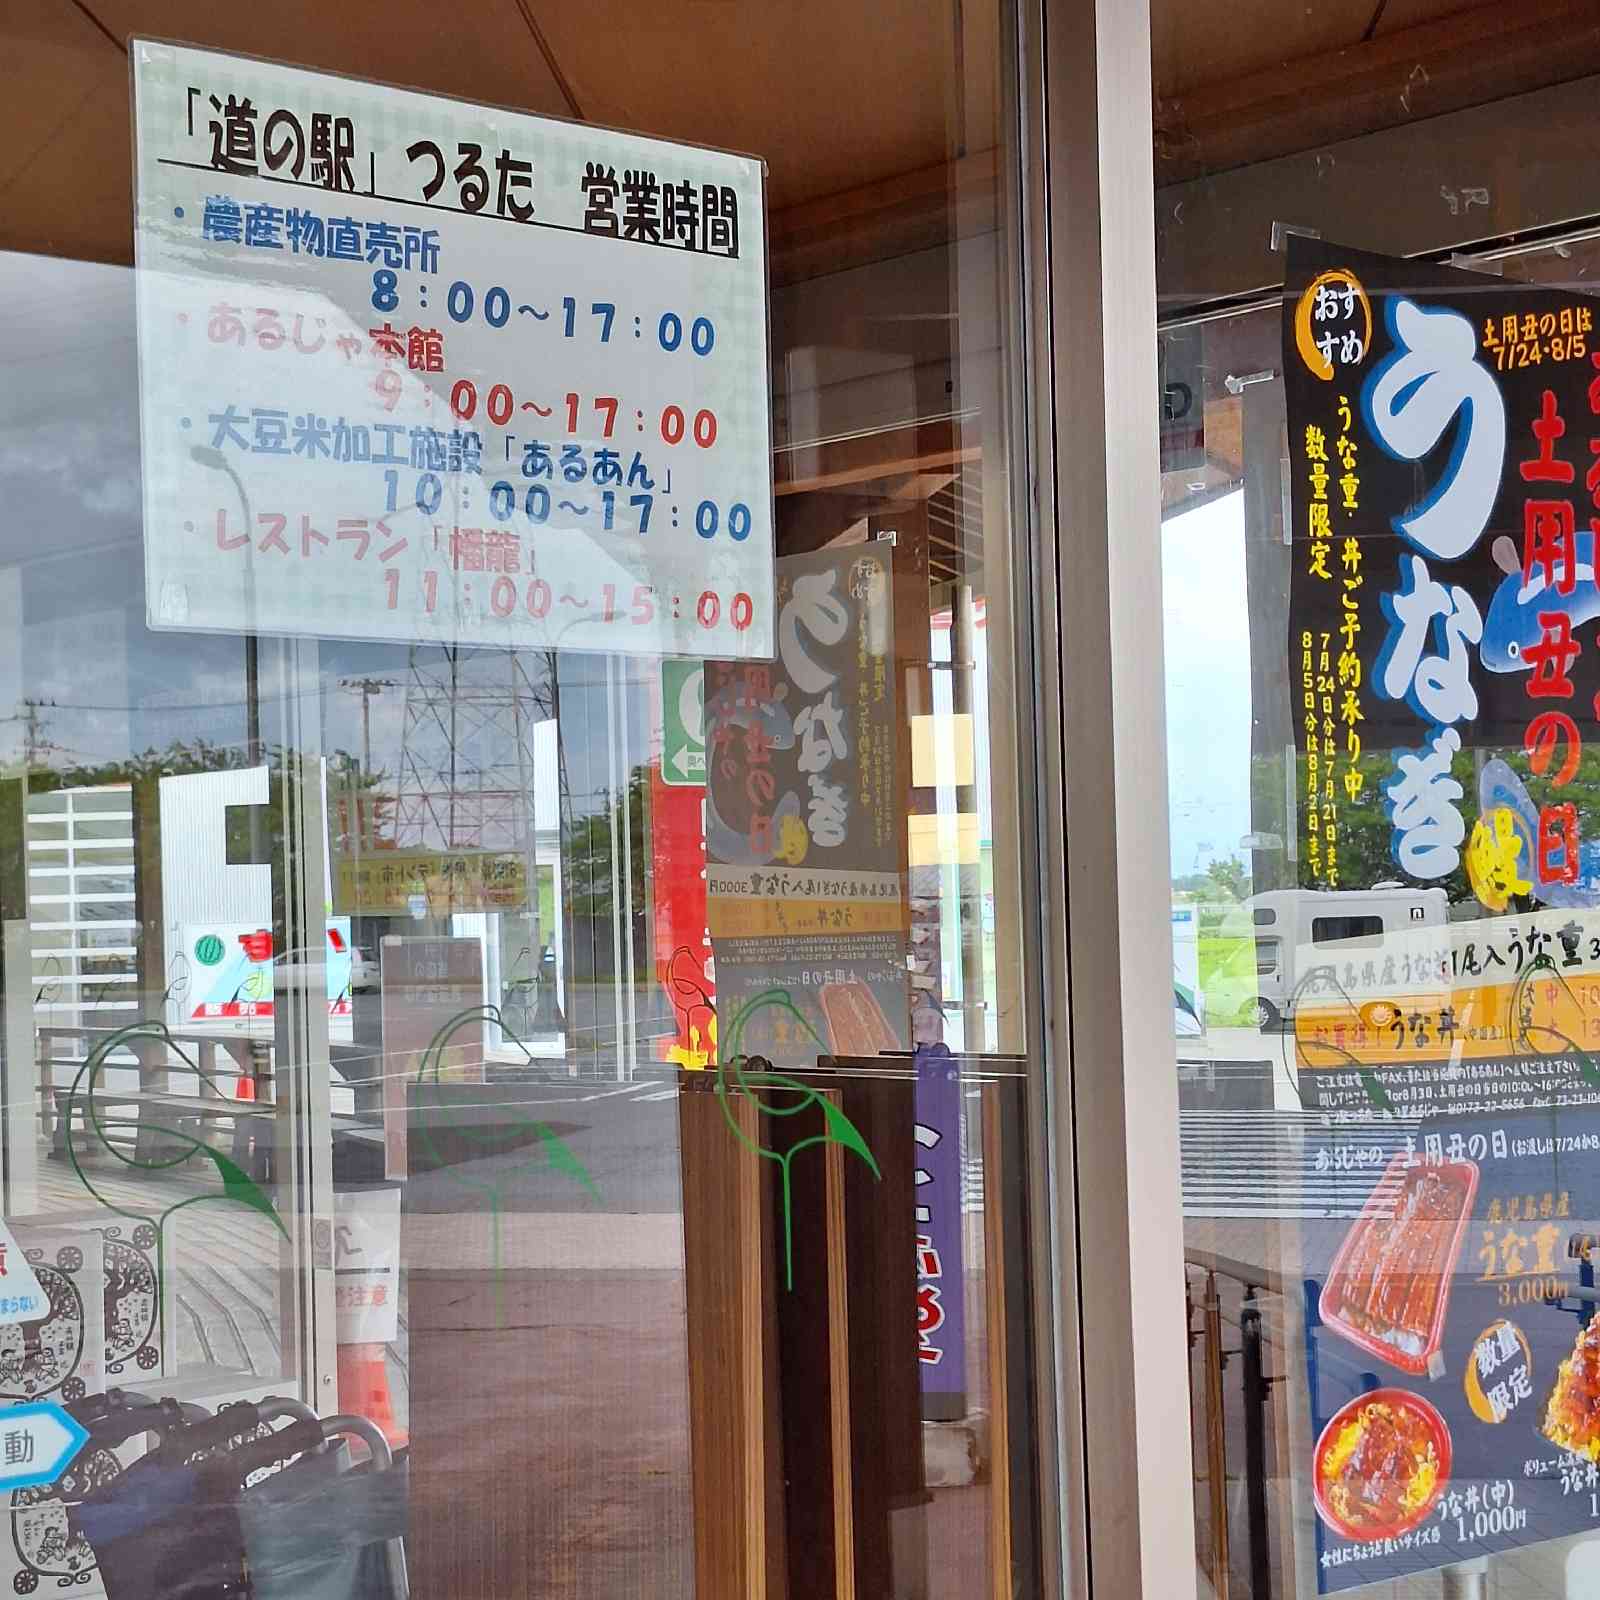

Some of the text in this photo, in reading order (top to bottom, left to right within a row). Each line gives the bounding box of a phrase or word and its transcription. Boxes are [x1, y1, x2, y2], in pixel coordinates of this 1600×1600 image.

[580, 162, 740, 258] 営業時間
[1482, 306, 1593, 348] 土用丑の日は
[1304, 424, 1334, 579] 数量限定
[1360, 292, 1507, 880] うなぎ
[1517, 388, 1583, 888] 土用丑の日
[1301, 631, 1322, 878] 8月5日分は8月2日まで
[1315, 632, 1340, 888] 7月24日分は7月21日まで
[1402, 1129, 1507, 1168] 土用丑の日
[5, 1429, 34, 1465] 動
[1457, 1504, 1527, 1542] 1,000円
